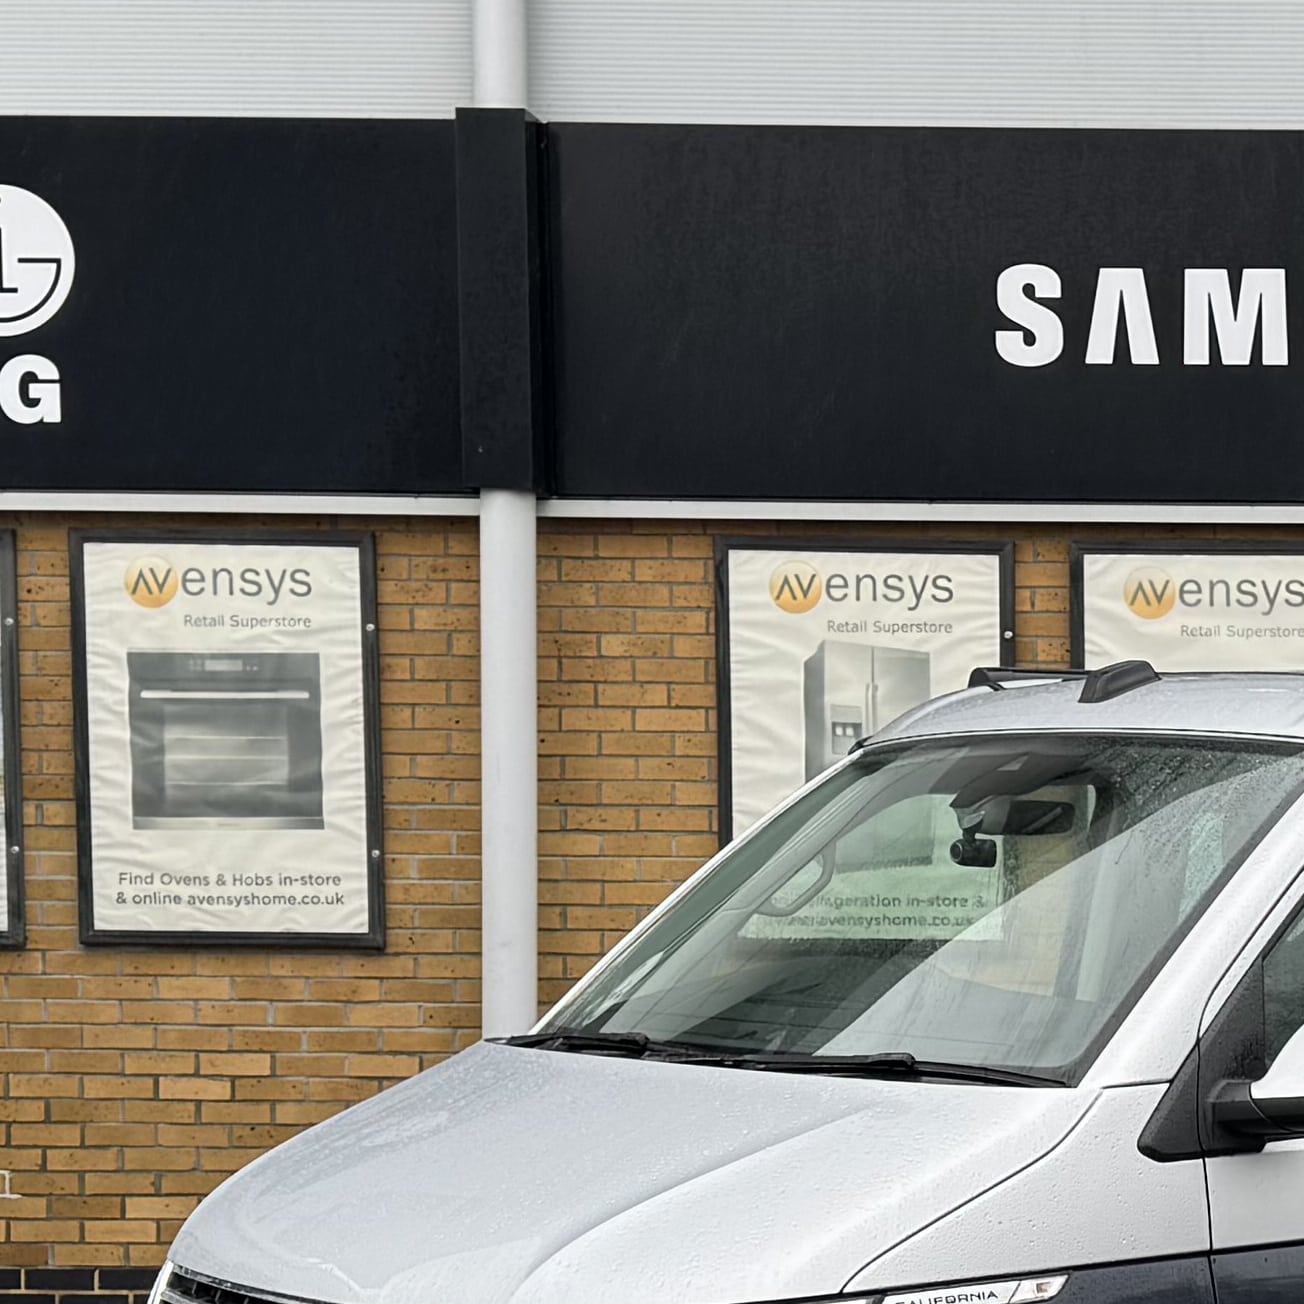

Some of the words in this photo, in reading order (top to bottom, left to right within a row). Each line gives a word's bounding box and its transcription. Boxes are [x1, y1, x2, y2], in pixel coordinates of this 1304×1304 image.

[184, 614, 225, 628] Retail
[230, 614, 312, 630] Superstore
[827, 620, 868, 633] Retail
[873, 620, 953, 635] Superstore
[1180, 625, 1221, 638] Retail
[119, 872, 154, 885] Find
[160, 872, 210, 886] Ovens
[216, 873, 227, 886] &
[232, 873, 273, 887] Hobs
[279, 873, 342, 886] in-store
[115, 891, 127, 904] &
[132, 891, 182, 905] online
[187, 892, 345, 908] avensyshome.co.uk
[906, 894, 969, 908] in-store
